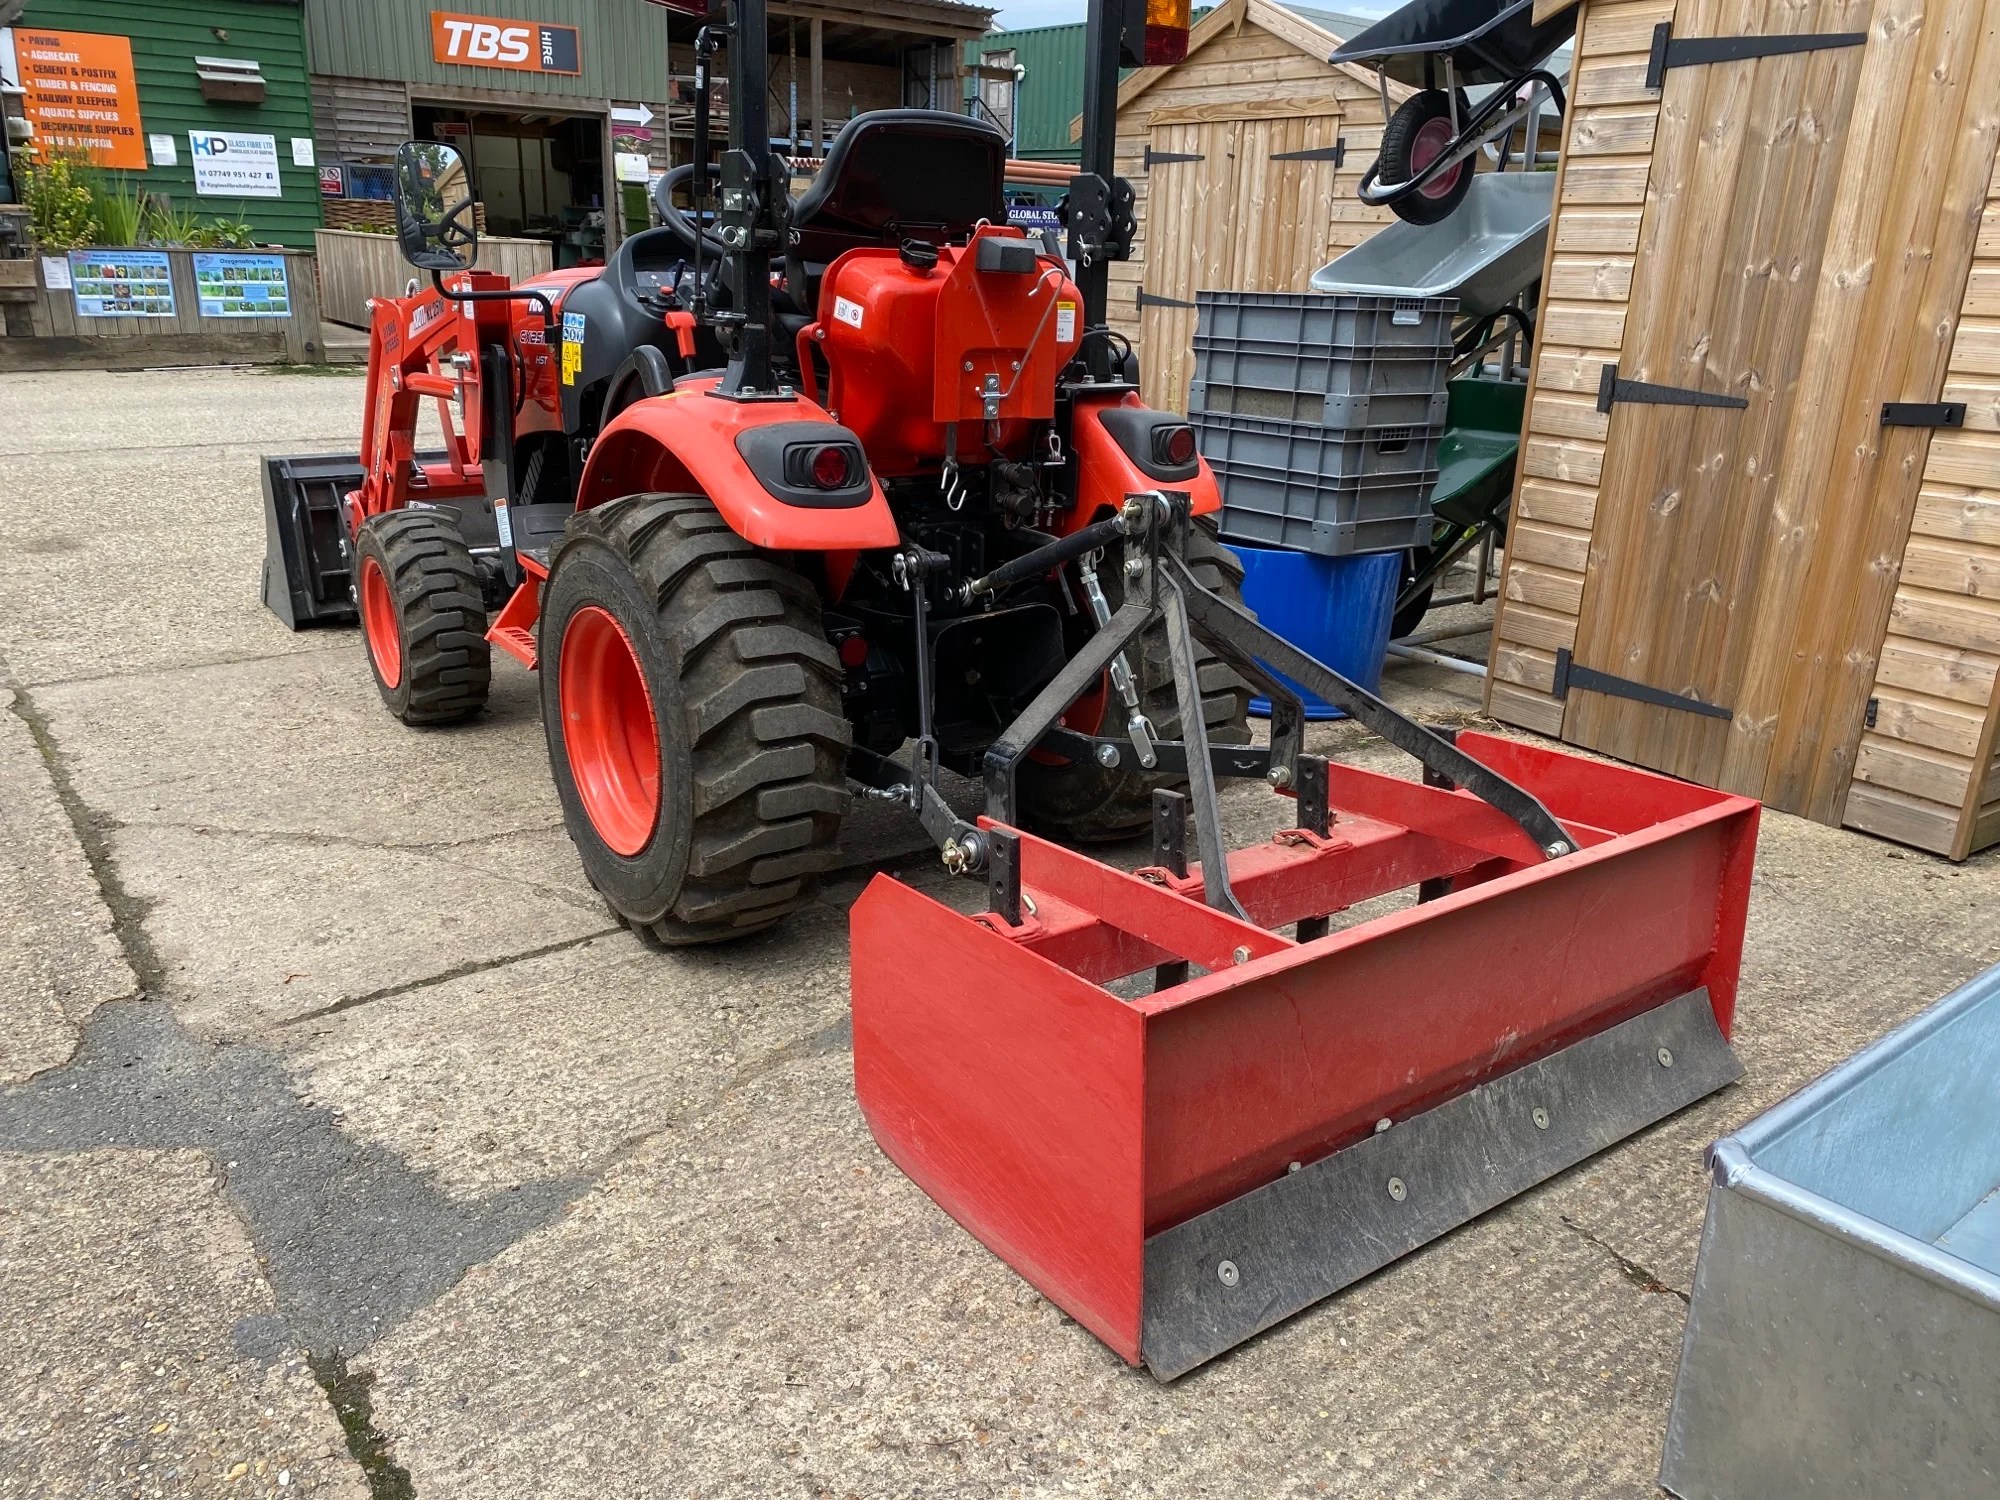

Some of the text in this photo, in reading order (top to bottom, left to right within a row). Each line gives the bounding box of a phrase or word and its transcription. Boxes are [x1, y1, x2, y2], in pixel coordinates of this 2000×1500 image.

[28, 36, 60, 47] PAVING
[443, 20, 554, 65] TBS HIRE
[30, 50, 80, 63] AGGREGATE
[33, 64, 117, 79] CEMENT & POSTFIX
[34, 78, 117, 93] TIMBER & FENCING
[36, 93, 117, 107] RAILWAY SLEEPERS
[39, 107, 119, 121] AQUATIC SUPPLIES
[95, 124, 134, 136] SUPPLIES
[192, 136, 273, 156] KP GLASS FIBRE LTD
[1008, 209, 1059, 220] GLOBAL STO
[219, 258, 257, 266] Oxygenating
[535, 355, 549, 365] HST
